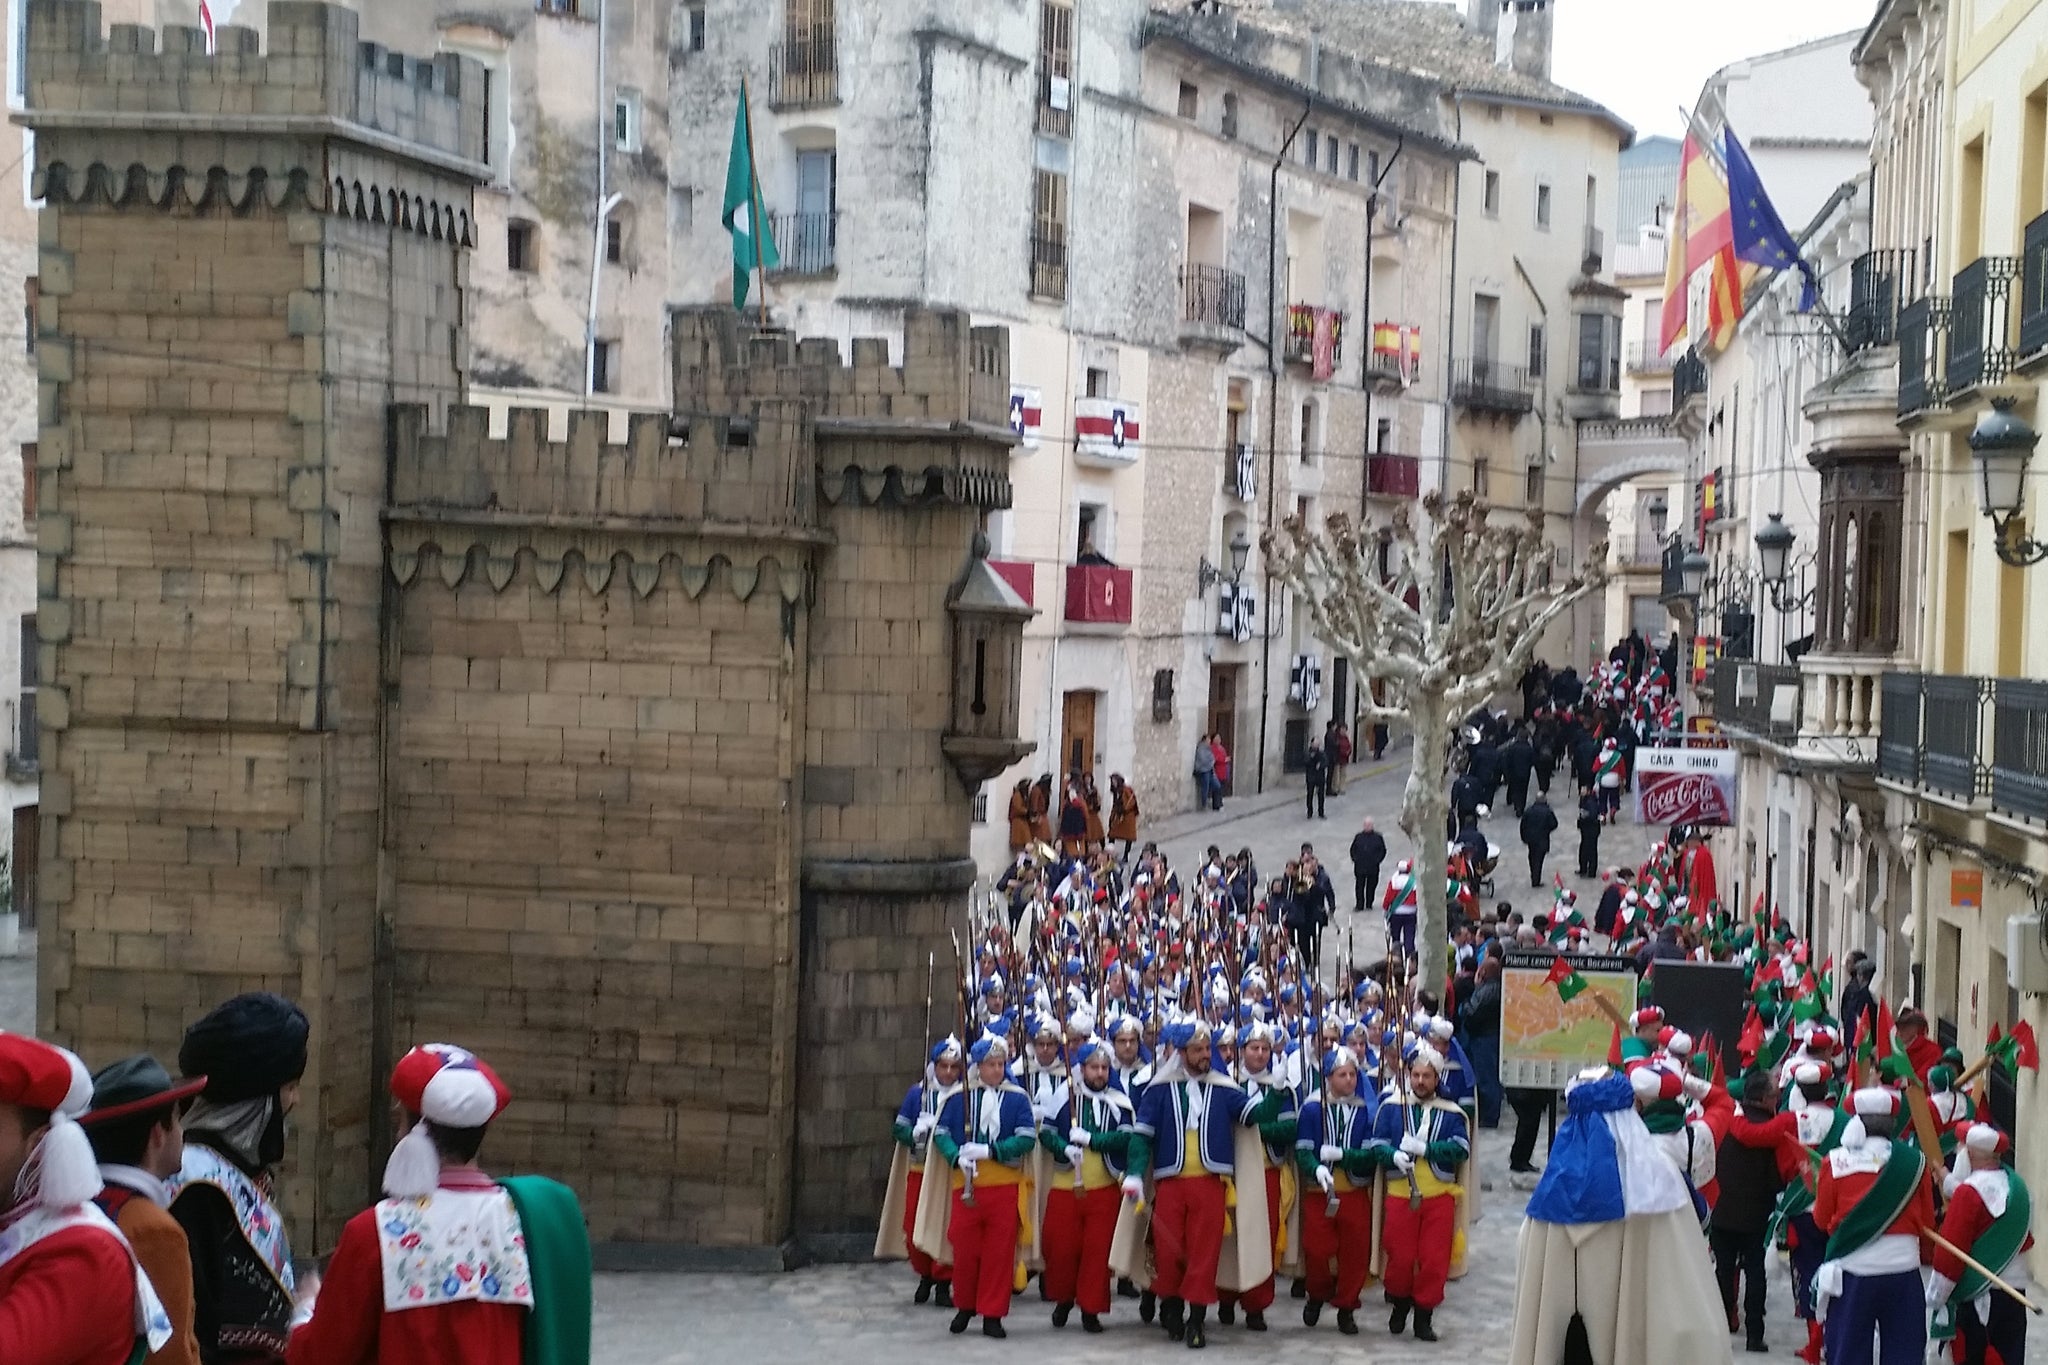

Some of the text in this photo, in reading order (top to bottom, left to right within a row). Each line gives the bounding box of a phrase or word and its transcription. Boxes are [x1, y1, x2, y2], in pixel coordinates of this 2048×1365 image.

[1650, 755, 1718, 768] CASA CHIMO
[1531, 956, 1555, 966] centre
[1587, 958, 1622, 969] Bocairent
